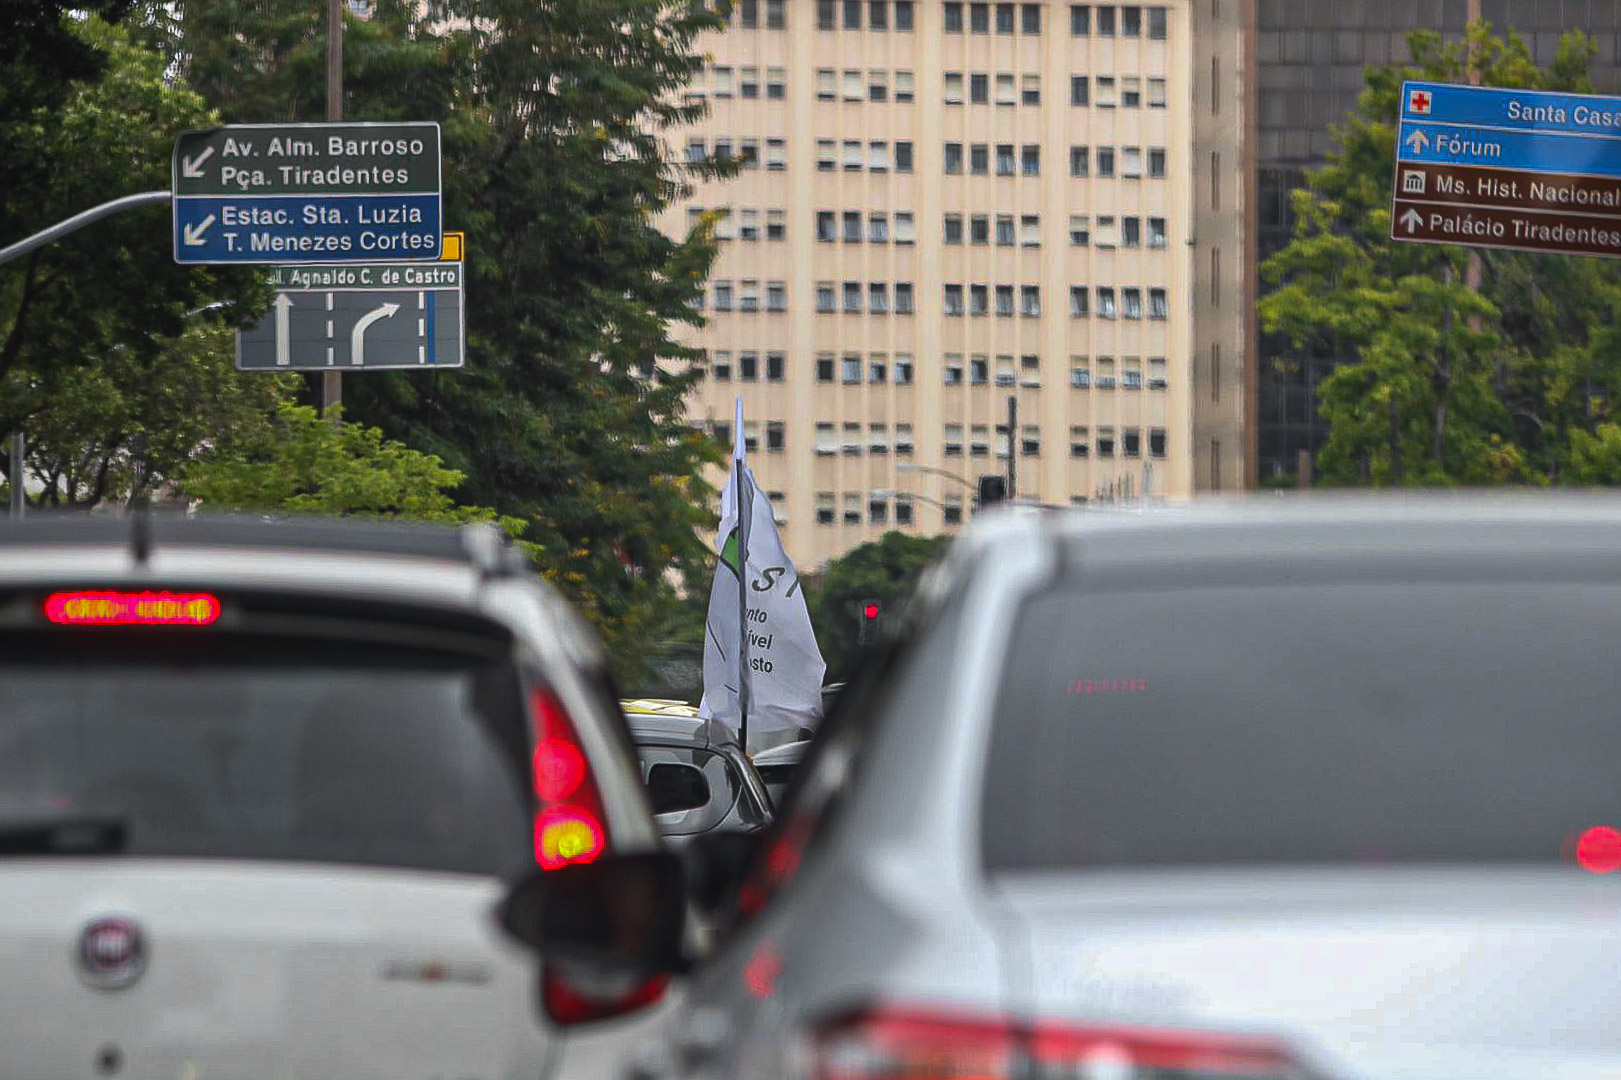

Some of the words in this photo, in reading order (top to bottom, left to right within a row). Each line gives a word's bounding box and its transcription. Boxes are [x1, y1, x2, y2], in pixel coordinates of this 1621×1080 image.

[1507, 101, 1566, 123] Santa
[1574, 106, 1621, 126] Casa
[222, 138, 259, 157] Av.
[267, 137, 320, 157] Alm.
[328, 136, 424, 156] Barroso
[1436, 133, 1502, 158] Fórum
[221, 166, 272, 190] Pça.
[279, 165, 409, 185] Tiradentes
[1436, 175, 1472, 195] Ms.
[1478, 178, 1523, 200] Hist.
[1530, 182, 1621, 207] Nacional
[222, 206, 294, 225] Estac.
[302, 205, 349, 225] Sta.
[358, 205, 422, 223] Luzia
[223, 233, 243, 252] T.
[250, 232, 352, 252] Menezes
[360, 231, 435, 250] Cortes
[1429, 213, 1505, 236] Palácio
[1511, 219, 1621, 246] Tiradentes
[290, 269, 356, 290] Agnaldo
[360, 269, 374, 284] C.
[382, 269, 400, 284] de
[405, 268, 456, 284] Castro
